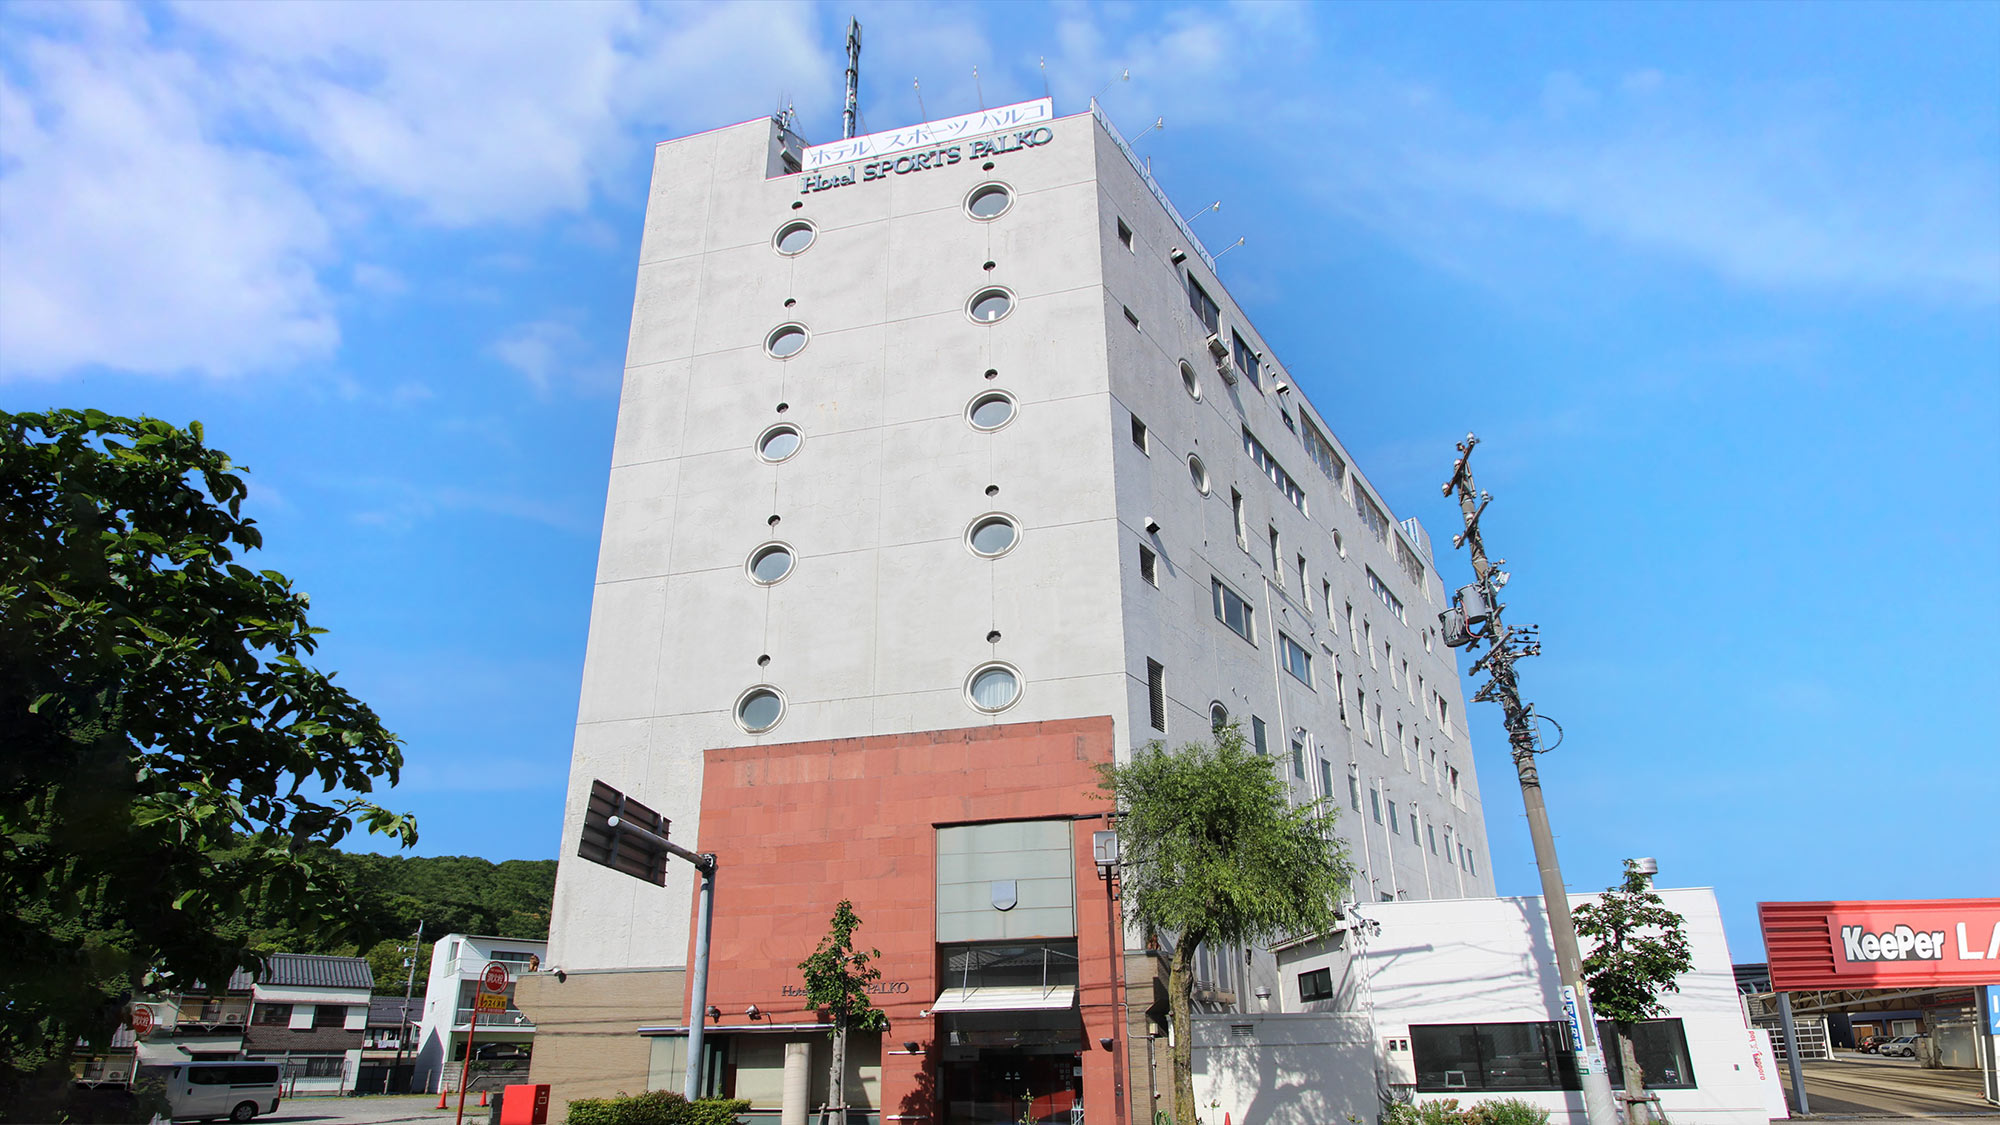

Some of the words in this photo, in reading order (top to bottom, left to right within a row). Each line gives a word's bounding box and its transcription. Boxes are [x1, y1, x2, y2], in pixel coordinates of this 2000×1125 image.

[811, 141, 873, 165] ホテル
[884, 119, 969, 149] スポーツ
[979, 104, 1044, 130] パルコ
[800, 165, 856, 194] Hotel
[863, 145, 961, 182] SPORTS
[969, 127, 1053, 160] PALKO
[1841, 925, 1945, 962] KeePer
[782, 985, 808, 997] Hote
[866, 981, 909, 994] PALKO
